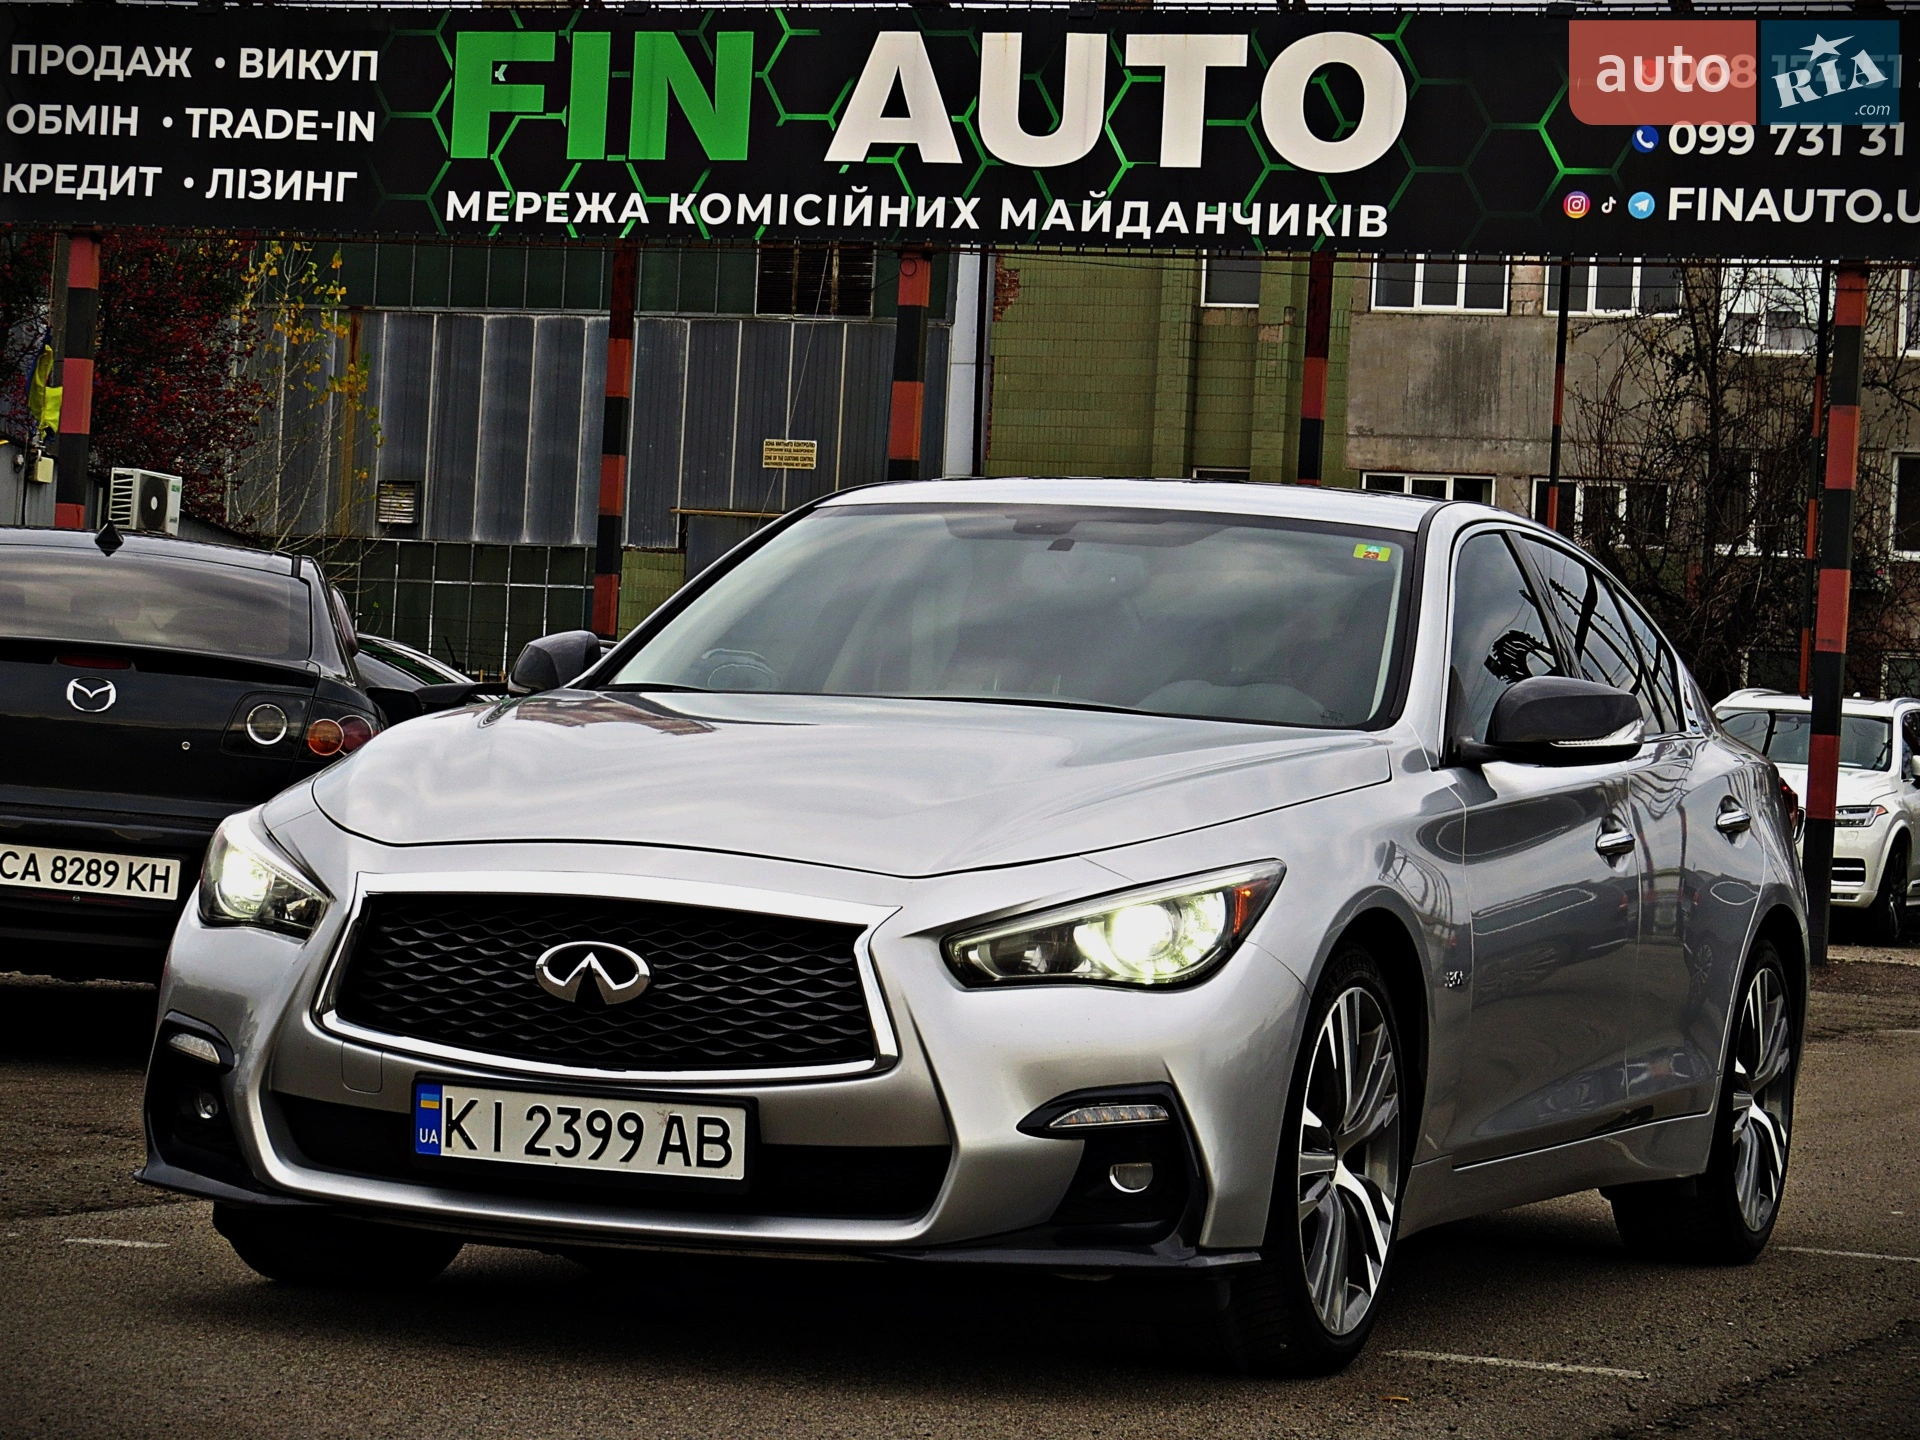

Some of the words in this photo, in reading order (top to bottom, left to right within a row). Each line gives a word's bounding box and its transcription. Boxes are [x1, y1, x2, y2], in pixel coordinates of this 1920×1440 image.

[11, 44, 193, 82] ПРОДАЖ
[239, 48, 379, 82] ВИКУП
[6, 103, 139, 137] ОБМІН
[450, 31, 754, 162] FIN
[823, 31, 1407, 174] AUTO
[185, 107, 376, 142] TRADE-IN
[1668, 120, 1755, 156] 099
[1769, 122, 1843, 156] 731
[1860, 122, 1905, 156] 31
[3, 163, 162, 201] КРЕДИТ
[205, 167, 358, 202] ЛІЗИНГ
[446, 190, 649, 224] МЕРЕЖА
[668, 186, 981, 230] КОМІСІЙНИХ
[1000, 191, 1388, 239] МАЙДАНЧИКІВ
[0, 850, 41, 883] CA
[50, 856, 120, 888] 8289
[126, 861, 171, 894] KH
[419, 1128, 439, 1144] UA
[445, 1097, 503, 1153] KI
[524, 1104, 645, 1163] 2399
[657, 1115, 733, 1169] AB
